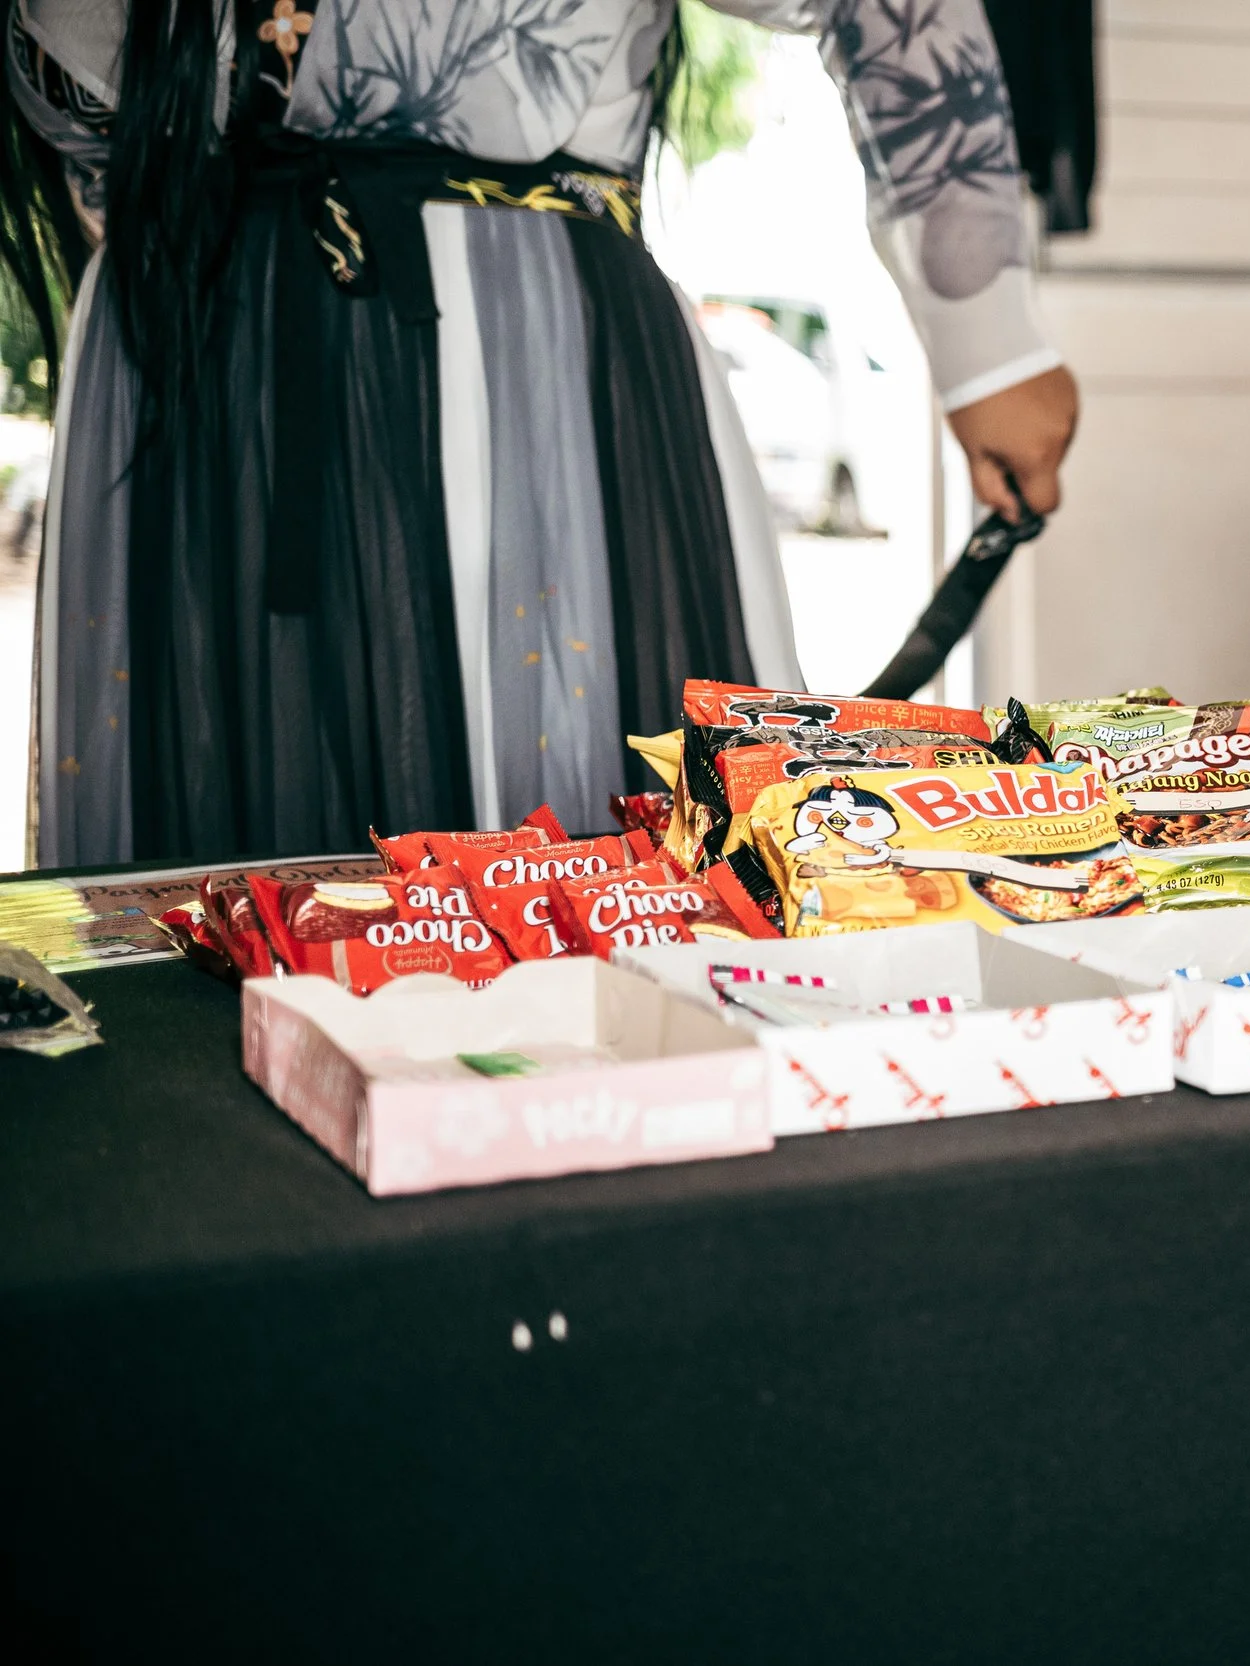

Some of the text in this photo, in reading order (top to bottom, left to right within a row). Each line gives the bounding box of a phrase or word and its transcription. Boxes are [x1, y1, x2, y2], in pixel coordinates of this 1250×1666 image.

[1094, 721, 1165, 747] 짜파게티
[888, 770, 1108, 830] Buldak
[959, 810, 1107, 842] Spicy Ramen
[1009, 837, 1039, 853] Spicy
[1039, 836, 1087, 850] Chicken
[1088, 824, 1118, 843] Flavo
[483, 855, 608, 887] Choco
[1195, 873, 1225, 887] (127g)
[406, 884, 473, 917] Pie
[587, 887, 705, 933] Choco
[366, 918, 493, 953] Choco
[610, 919, 682, 948] Pie
